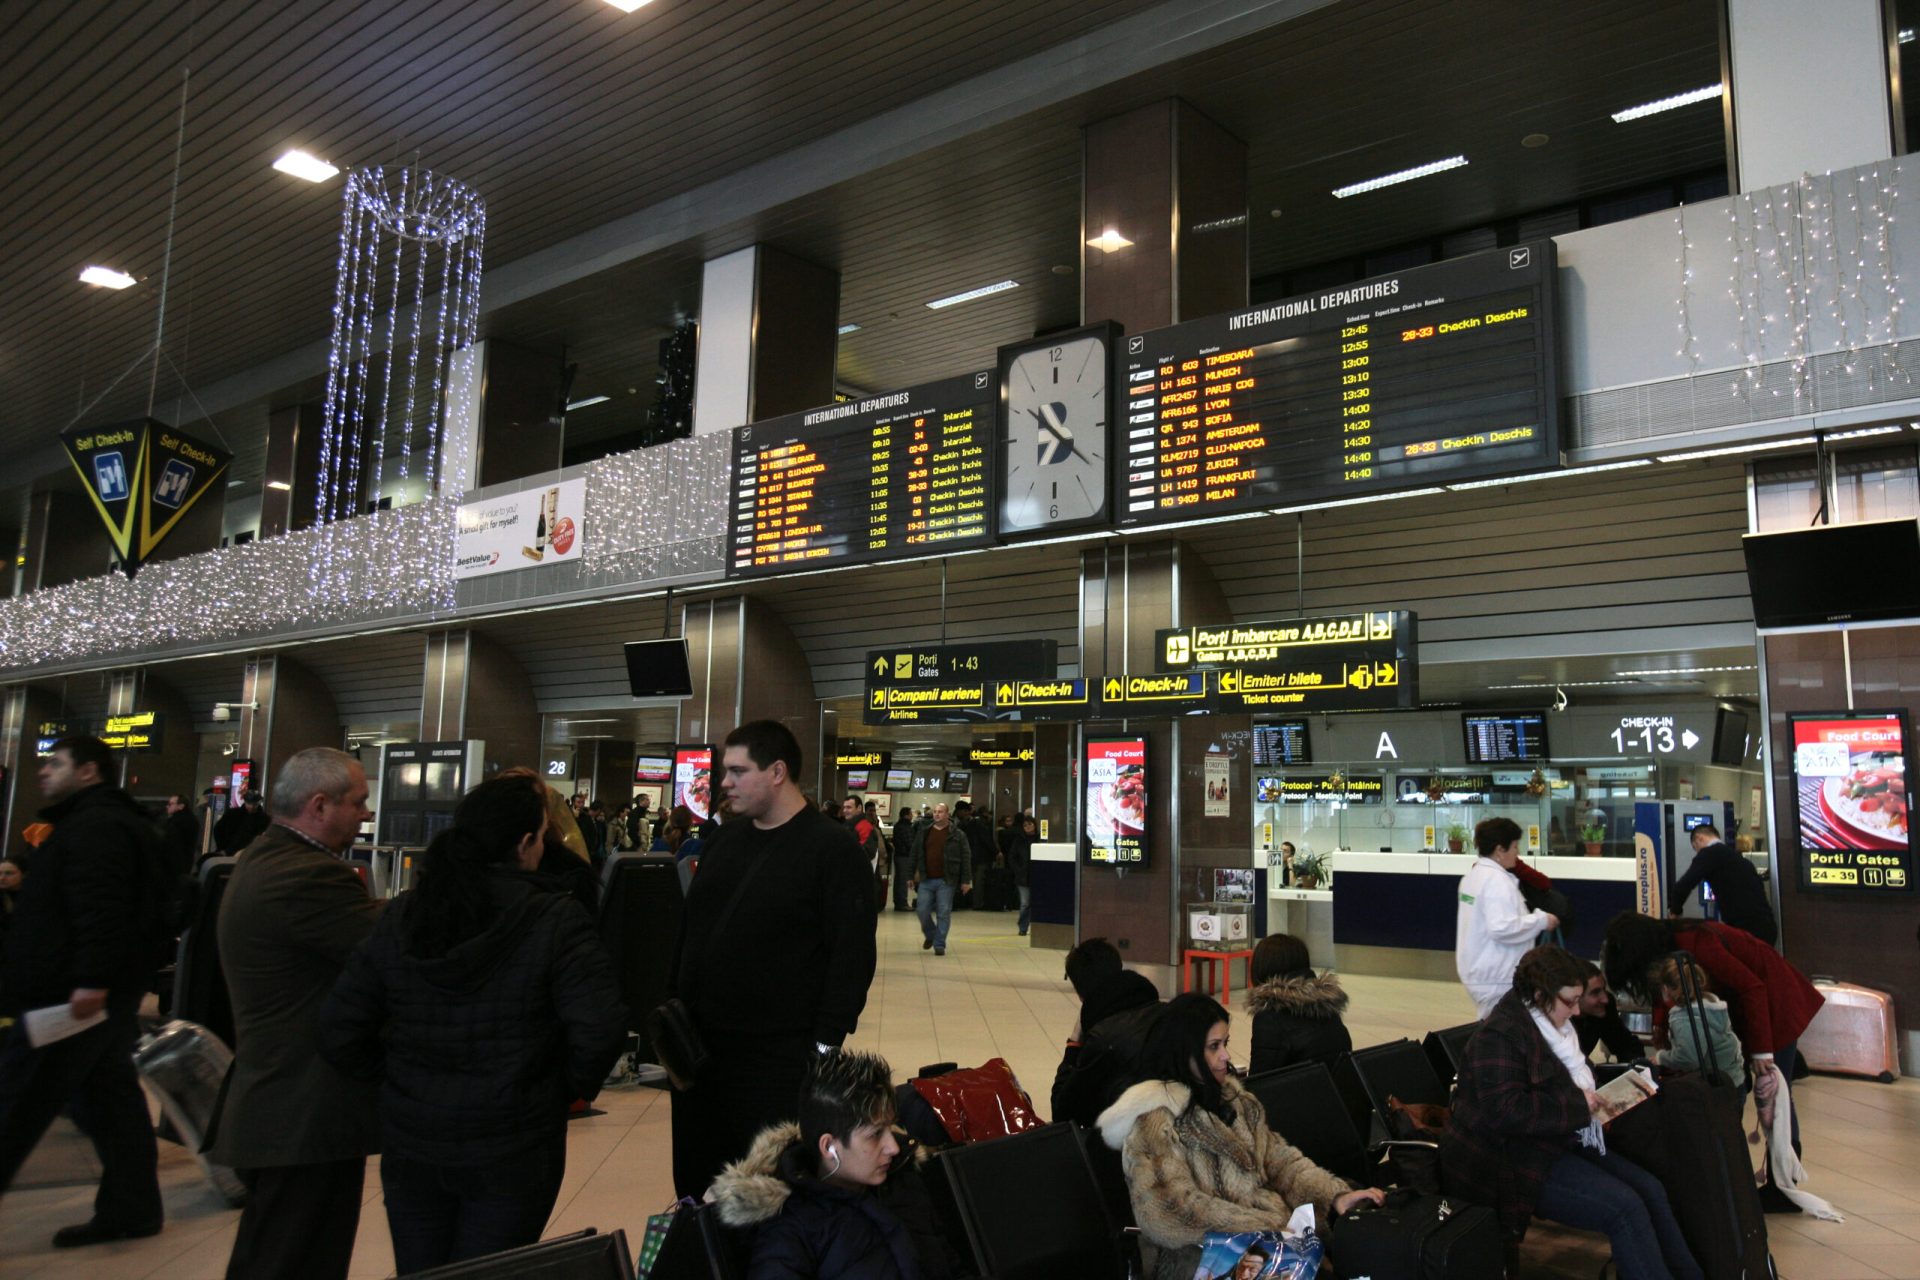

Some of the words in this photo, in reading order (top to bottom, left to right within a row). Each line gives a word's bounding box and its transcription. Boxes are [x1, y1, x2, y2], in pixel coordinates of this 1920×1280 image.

[1229, 299, 1318, 331] INTERNATIONAL
[1320, 280, 1399, 310] DEPARTURES
[1048, 347, 1063, 363] 12
[1161, 366, 1173, 376] RO
[1182, 360, 1199, 372] 603
[1206, 349, 1253, 366] TIMISOARA
[1341, 325, 1368, 338] 12:45
[1161, 380, 1172, 390] LH
[1177, 376, 1196, 387] 1651
[1206, 366, 1241, 381] MUNICH
[1341, 340, 1368, 354] 12:55
[1402, 326, 1434, 341] 28-33
[1162, 391, 1197, 405] AFR2457
[1205, 383, 1232, 396] PARIS
[1236, 379, 1254, 390] CDG
[1342, 356, 1369, 370] 13:00
[1162, 405, 1197, 419] AFR6166
[1205, 399, 1229, 411] LYON
[1342, 372, 1369, 385] 13:10
[804, 405, 859, 426] INTERNATIONAL
[860, 392, 910, 413] DEPARTURES
[1161, 424, 1173, 434] QR
[1182, 420, 1199, 429] 943
[1205, 413, 1232, 425] SOFIA
[1343, 388, 1370, 401] 13:30
[1161, 439, 1171, 448] KL
[1176, 435, 1196, 446] 1374
[1206, 423, 1259, 440] AMSTERDAM
[1343, 404, 1370, 417] 14:00
[76, 438, 94, 451] Self
[160, 434, 178, 448] Self
[1161, 450, 1199, 463] KLM2719
[1206, 438, 1265, 455] CLUJ-NAPOCA
[1343, 420, 1371, 432] 14:20
[1161, 468, 1172, 477] UA
[1177, 464, 1197, 475] 9787
[1206, 457, 1238, 470] ZURICH
[1344, 435, 1371, 448] 14:30
[1161, 483, 1172, 492] LH
[1177, 479, 1197, 490] 1419
[1206, 470, 1256, 486] FRANKFURT
[1344, 452, 1371, 465] 14:40
[1405, 441, 1436, 456] 28-33
[1161, 497, 1173, 507] RO
[1178, 494, 1199, 505] 9409
[1206, 488, 1235, 501] MILAN
[1344, 468, 1372, 480] 14:40
[1050, 504, 1059, 519] 6
[489, 521, 498, 529] for
[1302, 620, 1363, 641] A,B,C,D,E
[1196, 651, 1225, 662] Gates
[1226, 647, 1278, 661] A,B,C,D,E
[951, 658, 957, 671] 1
[965, 656, 979, 671] 43
[918, 667, 939, 678] Gates
[1242, 675, 1285, 688] Emiteri
[1288, 672, 1322, 686] bilete
[1019, 682, 1072, 698] Check-in
[1130, 678, 1188, 693] Check-in
[890, 689, 940, 703] Companii
[940, 688, 981, 701] aeriene
[1242, 694, 1268, 705] Ticket
[1270, 692, 1305, 703] counter
[889, 710, 918, 720] Airlines
[1621, 716, 1674, 728] CHECK-IN
[1610, 726, 1675, 753] 1-13
[1827, 732, 1859, 742] Food
[1861, 730, 1901, 742] Court
[1375, 731, 1398, 759] A
[548, 760, 566, 775] 28
[914, 778, 925, 788] 33
[929, 778, 940, 789] 34
[1280, 781, 1313, 790] Protocol
[1810, 853, 1844, 865] Porti
[1856, 854, 1900, 866] Gates
[1812, 871, 1828, 880] 24
[1840, 871, 1856, 881] 39
